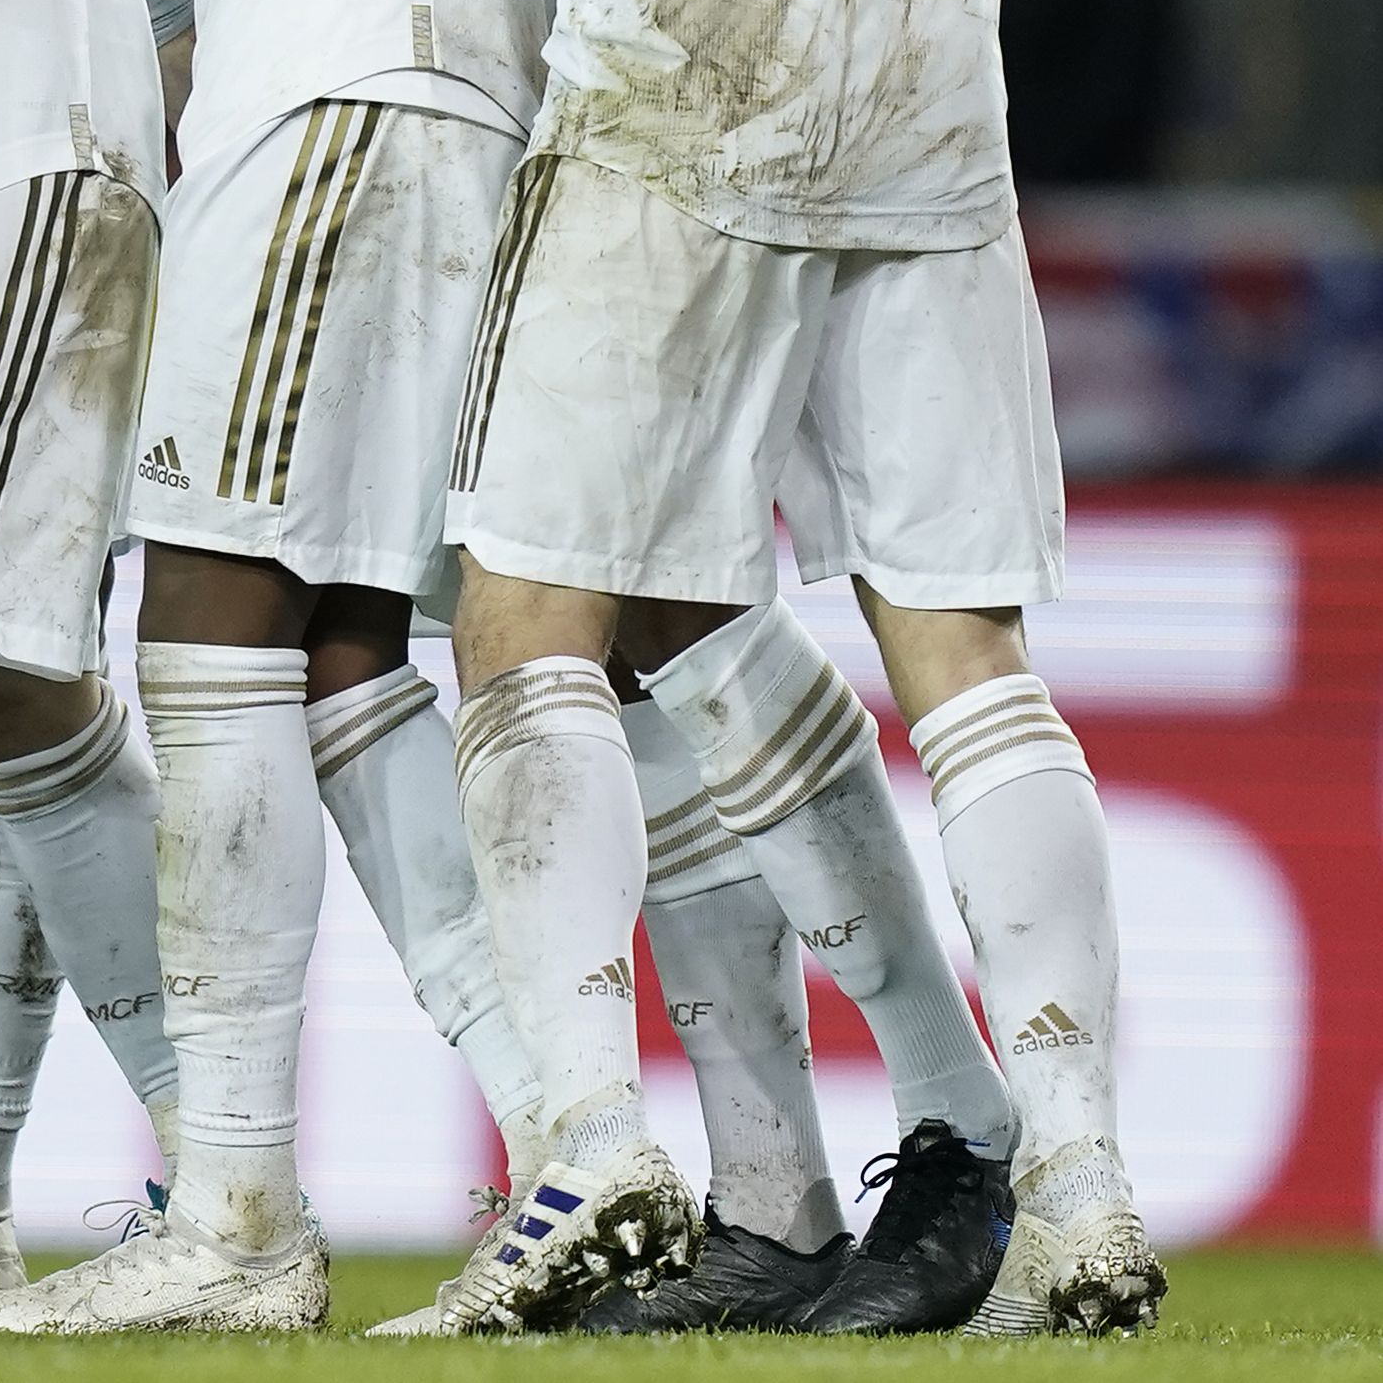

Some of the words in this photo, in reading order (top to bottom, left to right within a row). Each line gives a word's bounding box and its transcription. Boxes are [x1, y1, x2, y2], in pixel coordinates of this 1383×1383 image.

[138, 460, 191, 491] adidas
[799, 915, 867, 951] MCF
[85, 992, 159, 1022] MCF
[1013, 1027, 1094, 1056] adidas
